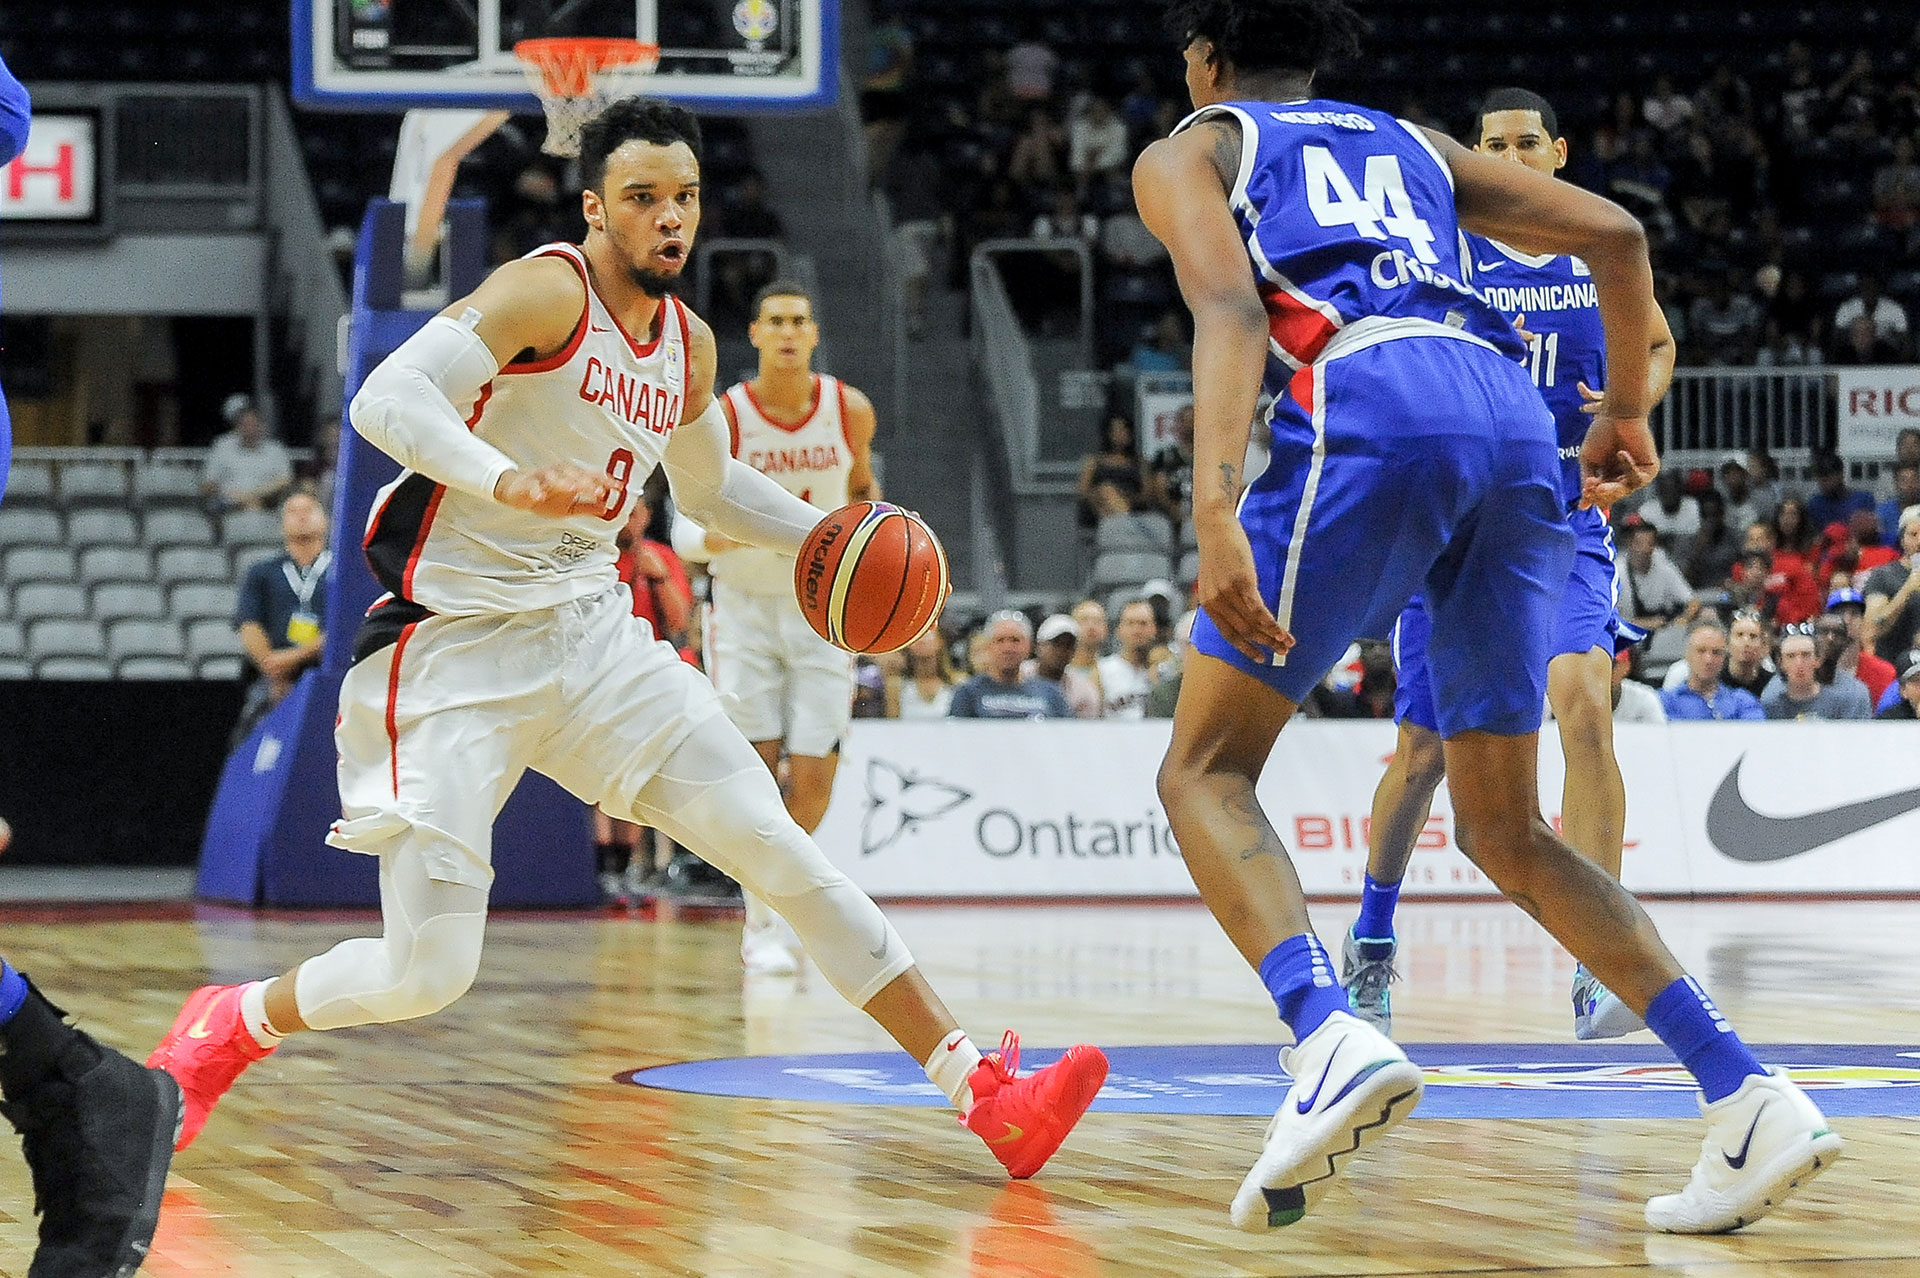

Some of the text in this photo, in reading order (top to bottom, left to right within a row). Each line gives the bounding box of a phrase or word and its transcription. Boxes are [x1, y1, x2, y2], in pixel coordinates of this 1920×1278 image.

[1303, 144, 1440, 265] 44
[1484, 283, 1599, 312] DOMINICANA
[1529, 332, 1558, 387] 11
[579, 356, 679, 436] CANADA
[749, 446, 839, 474] CANADA
[806, 523, 843, 610] molten
